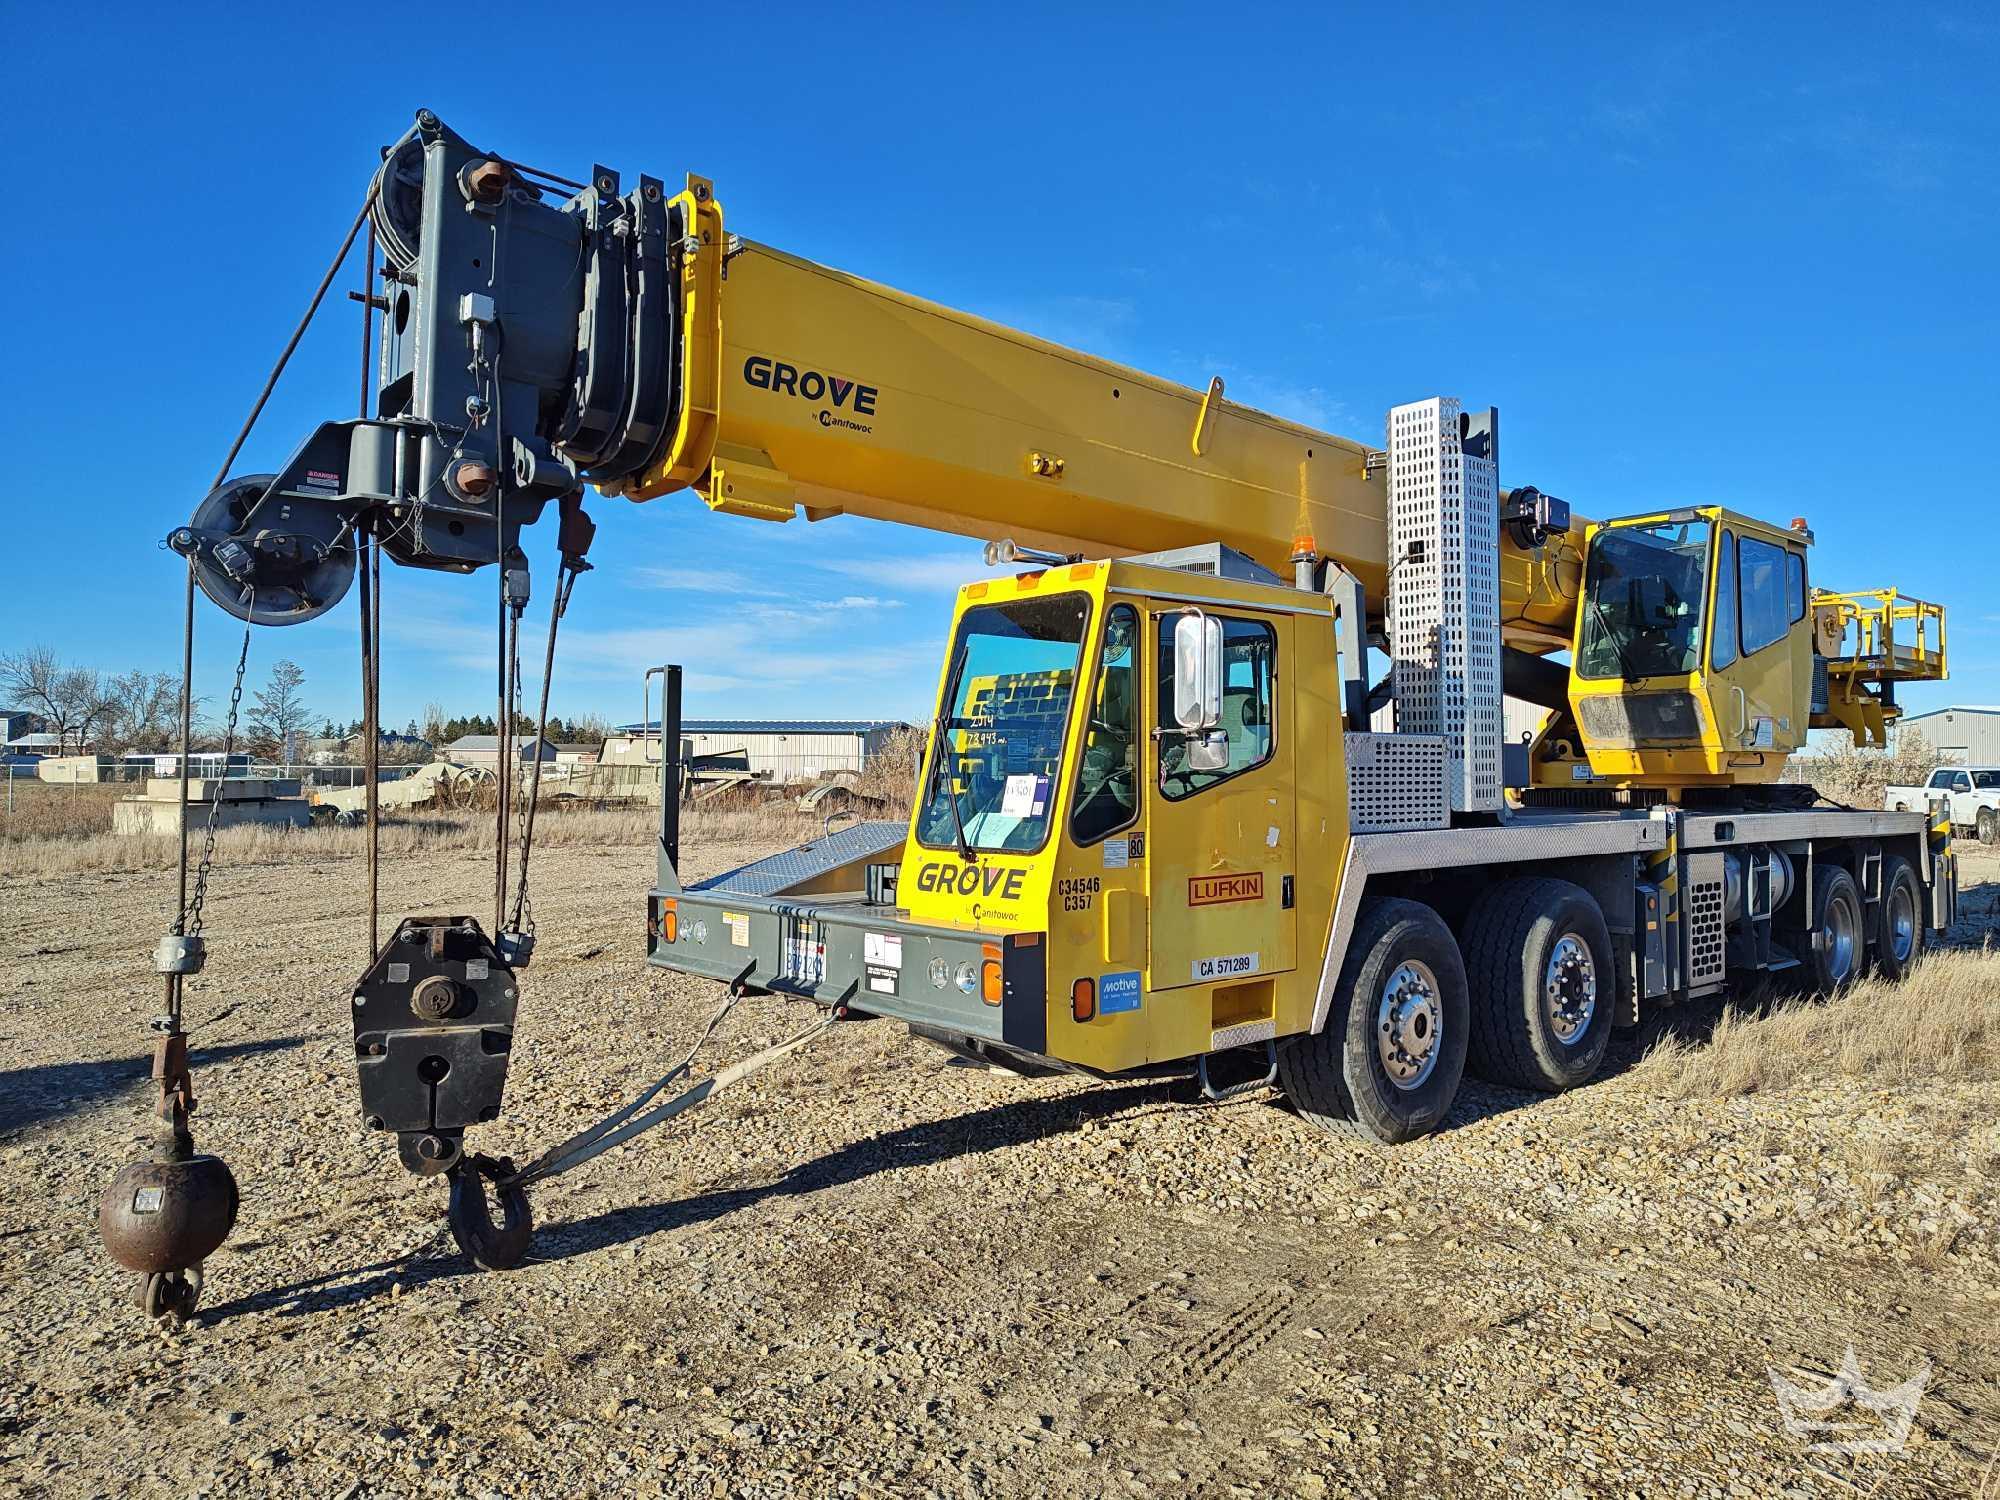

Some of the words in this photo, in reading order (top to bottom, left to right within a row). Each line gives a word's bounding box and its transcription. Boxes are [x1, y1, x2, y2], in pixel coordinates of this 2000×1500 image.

[743, 356, 878, 416] GROVE
[819, 410, 873, 434] Manitowoc
[1130, 838, 1144, 856] 80
[917, 863, 1027, 900] GROVE
[1058, 877, 1100, 896] C34546
[1194, 879, 1258, 899] LUFKIN
[972, 903, 1019, 921] Manitowoc
[1064, 895, 1092, 911] C357
[1200, 961, 1214, 976] CA
[1217, 956, 1250, 974] 571289
